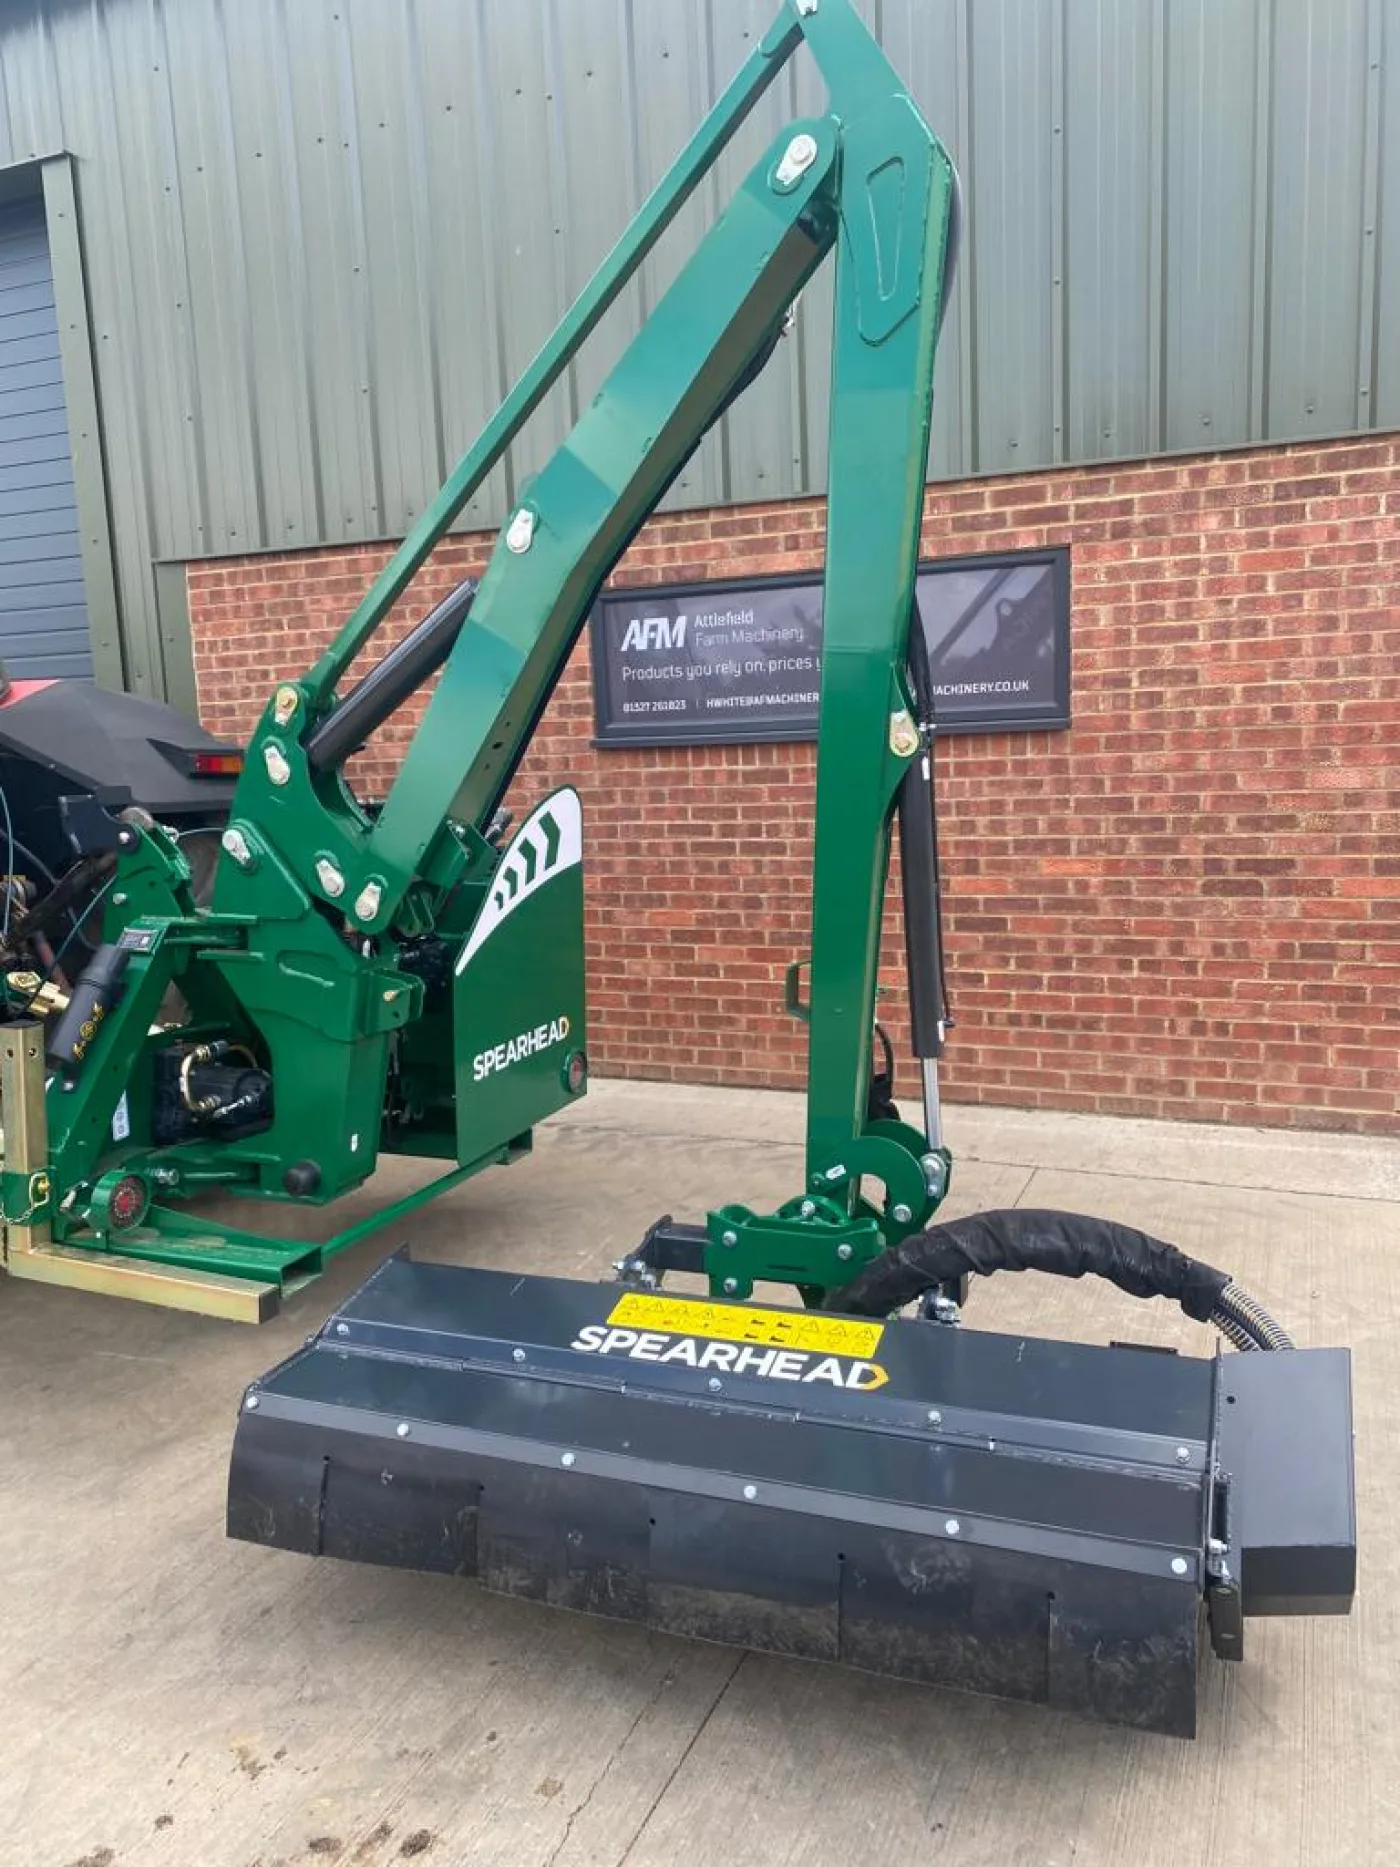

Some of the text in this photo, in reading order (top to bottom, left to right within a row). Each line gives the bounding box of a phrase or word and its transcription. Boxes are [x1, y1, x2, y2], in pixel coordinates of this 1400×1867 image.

[694, 609, 754, 627] Attlefield
[620, 615, 687, 651] AFM
[695, 628, 804, 646] Farm Machinery
[622, 665, 684, 681] Products
[686, 663, 712, 680] you
[715, 659, 741, 677] rely
[768, 656, 812, 675] prices
[706, 692, 820, 708] HWHITE@AFMACHINER
[473, 1015, 570, 1082] SPEARHEAD
[570, 1325, 889, 1391] SPEARHEAD
